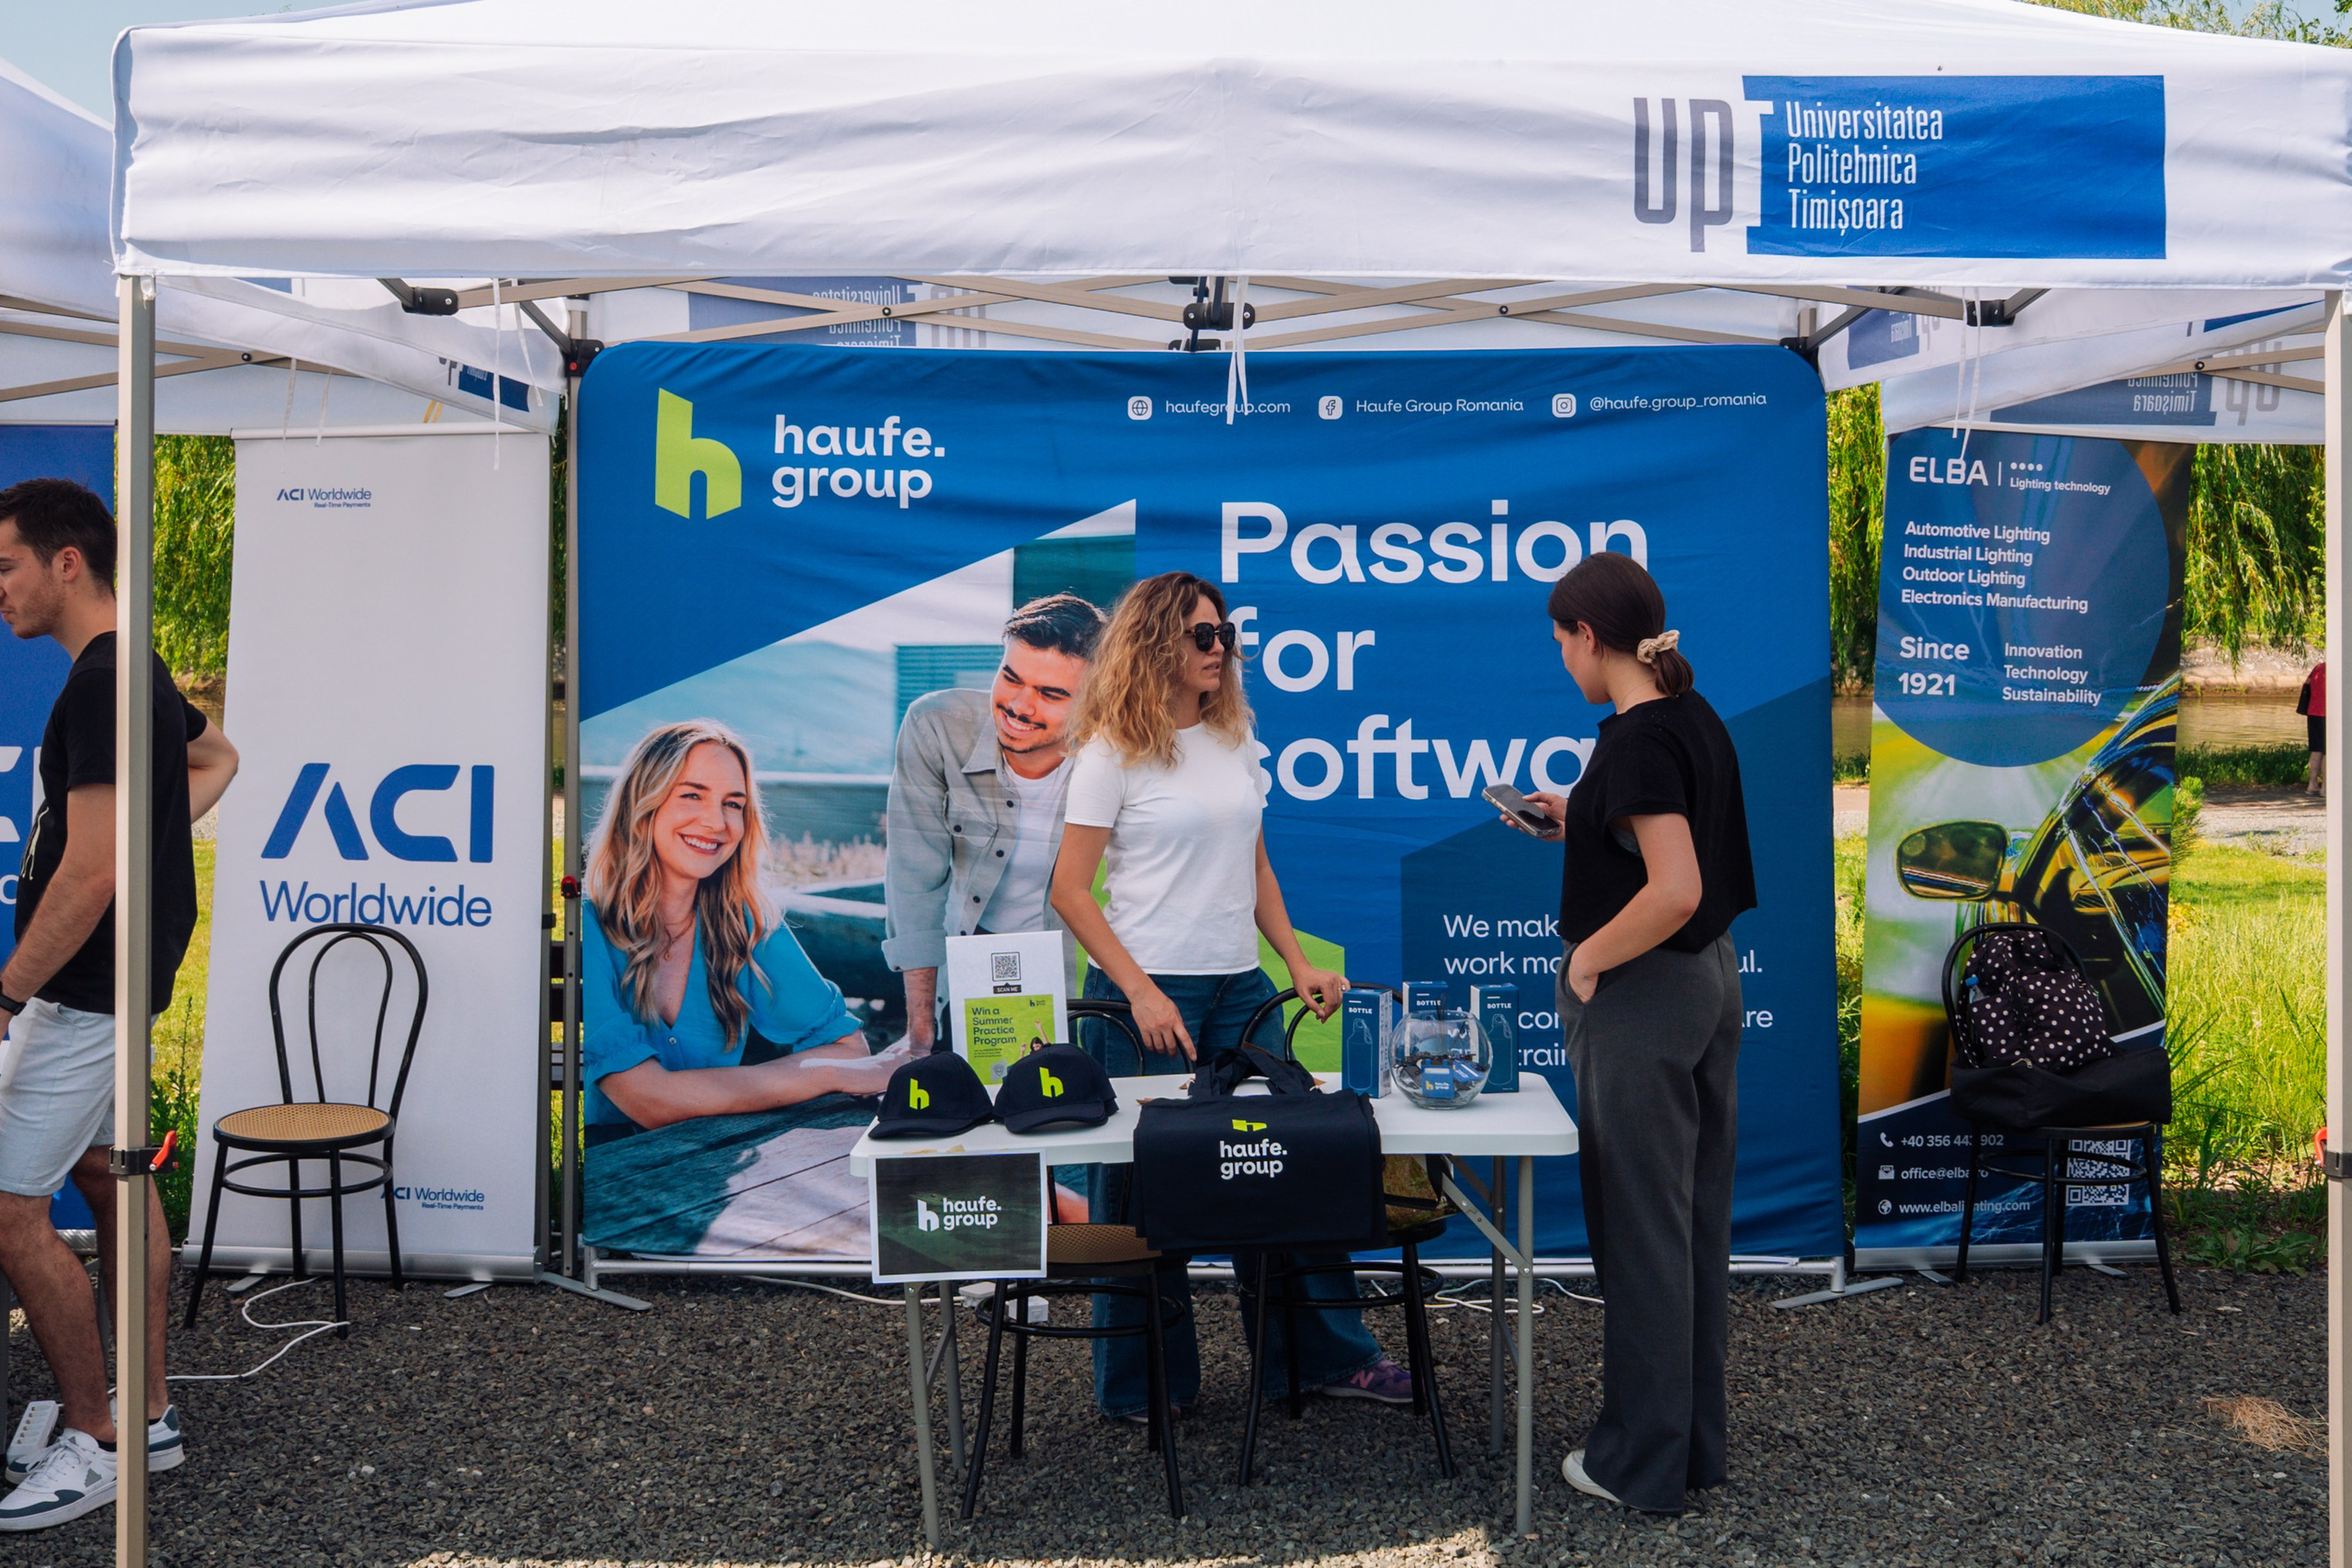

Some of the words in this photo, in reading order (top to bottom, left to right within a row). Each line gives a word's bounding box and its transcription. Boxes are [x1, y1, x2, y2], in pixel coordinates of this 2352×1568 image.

[1785, 100, 1943, 141] Universitatea
[1787, 142, 1917, 185] Politehnica
[1356, 400, 1402, 412] Haufe
[1405, 399, 1453, 415] Group
[1456, 398, 1524, 412] Romania
[1589, 391, 1768, 412] @haufe.group_romania
[774, 413, 946, 458] haufe.
[1908, 456, 1989, 487] ELBA
[276, 488, 304, 502] ACI
[308, 488, 372, 502] Worldwide
[771, 464, 933, 509] group
[2009, 477, 2052, 491] Lighting
[2054, 480, 2111, 496] technology
[1221, 499, 1648, 585] Passion
[1904, 521, 1991, 540] Automotive
[1994, 525, 2051, 546] Lighting
[1904, 543, 1973, 561] Industrial
[1975, 547, 2033, 567] Lighting
[1902, 566, 1965, 583] Outdoor
[1968, 569, 2026, 589] Lighting
[1901, 588, 1983, 607] Electronics
[1985, 592, 2088, 615] Manufacturing
[1899, 636, 1971, 660] Since
[2004, 642, 2083, 660] Innovation
[1897, 671, 1956, 696] 1921
[2003, 664, 2088, 684] Technology
[2002, 686, 2102, 706] Sustainability
[1255, 713, 1597, 801] oftwa
[260, 762, 495, 863] ACI
[259, 880, 492, 928] Worldwide
[1442, 914, 1490, 938] We
[1497, 913, 1561, 937] mak
[1443, 951, 1516, 975] work
[972, 1007, 991, 1016] Win
[972, 1017, 1013, 1026] Summer
[1348, 1007, 1374, 1015] BOTTLE
[973, 1026, 1015, 1035] Practice
[974, 1036, 1017, 1046] Program
[1219, 1138, 1288, 1158] haufe.
[1900, 1135, 1925, 1147] +40
[1927, 1134, 1951, 1146] 356
[1980, 1134, 2005, 1145] 902
[1220, 1159, 1283, 1180] group
[380, 1186, 411, 1200] CI
[414, 1187, 485, 1202] Worldwide
[943, 1195, 1002, 1213] haufe.
[421, 1201, 452, 1210] Real-Time
[452, 1202, 484, 1212] Payments
[943, 1211, 999, 1232] group
